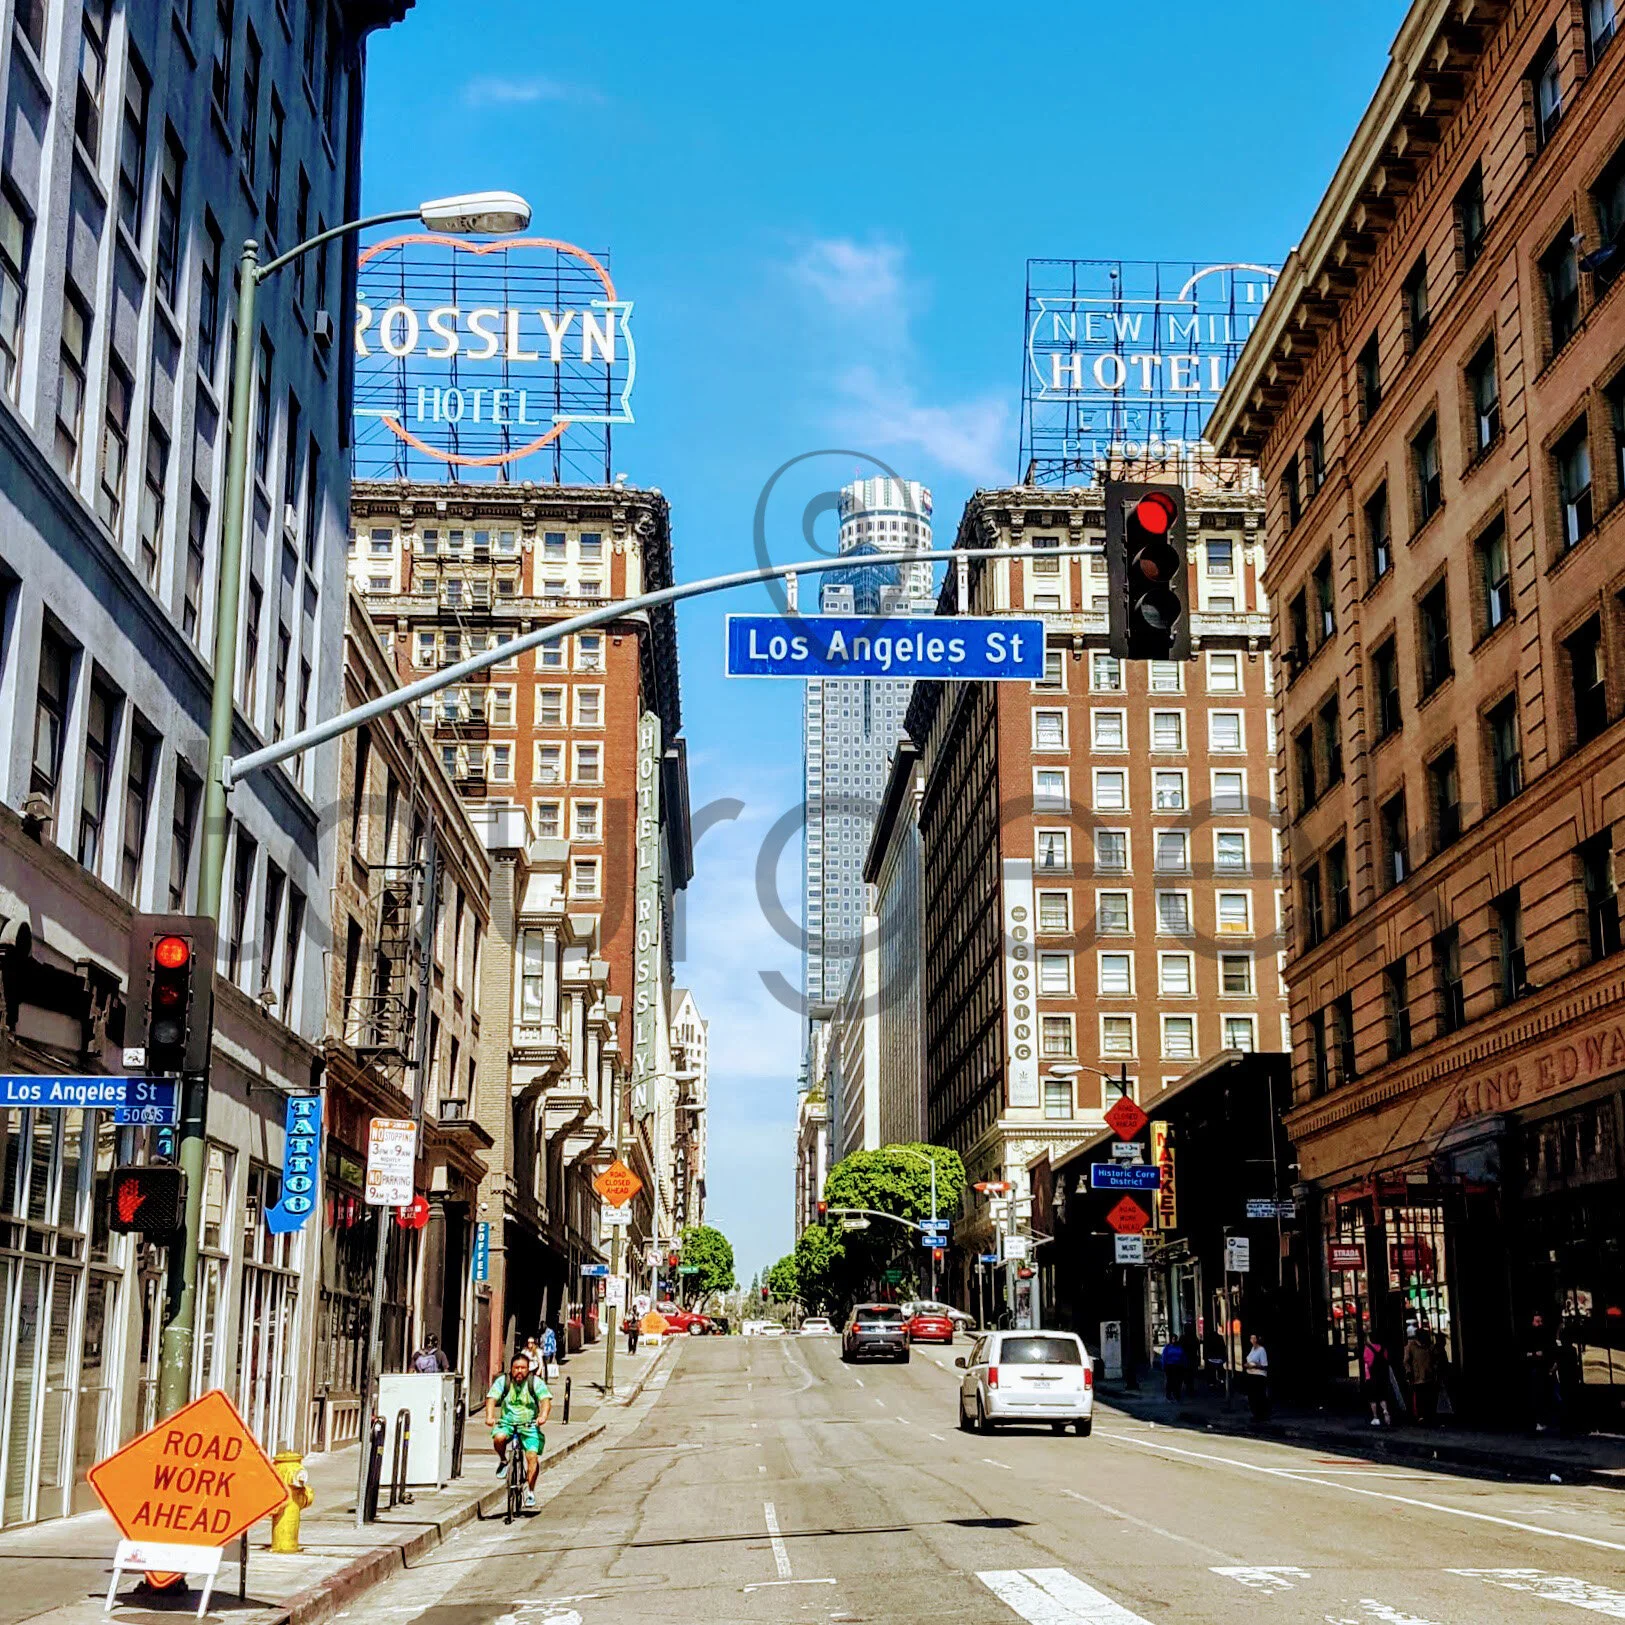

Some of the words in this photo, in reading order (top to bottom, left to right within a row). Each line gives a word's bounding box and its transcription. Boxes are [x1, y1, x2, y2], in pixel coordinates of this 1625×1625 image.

[355, 303, 616, 364] ROSSLYN
[1053, 311, 1143, 342] NEW
[1051, 353, 1226, 392] HOTEL
[417, 384, 540, 426] HOTEL
[749, 628, 809, 661] Los
[826, 629, 966, 671] Angeles
[985, 632, 1024, 663] St
[640, 727, 653, 870] HOTEL
[635, 899, 652, 1107] ROSSLYN
[1013, 926, 1030, 1058] LEASING
[7, 1081, 41, 1100] Los
[50, 1081, 127, 1105] Angeles
[135, 1082, 158, 1101] St
[371, 1128, 384, 1141] NO
[285, 1099, 317, 1214] TATTOO
[1099, 1169, 1132, 1178] Historic
[1135, 1170, 1156, 1179] Core
[382, 1175, 411, 1187] PARKING
[1110, 1177, 1144, 1186] District
[1157, 1132, 1175, 1227] MARKET
[477, 1222, 486, 1280] COFFEE
[162, 1430, 243, 1462] ROAD
[153, 1464, 236, 1498] WORK
[131, 1501, 232, 1535] AHEAD
